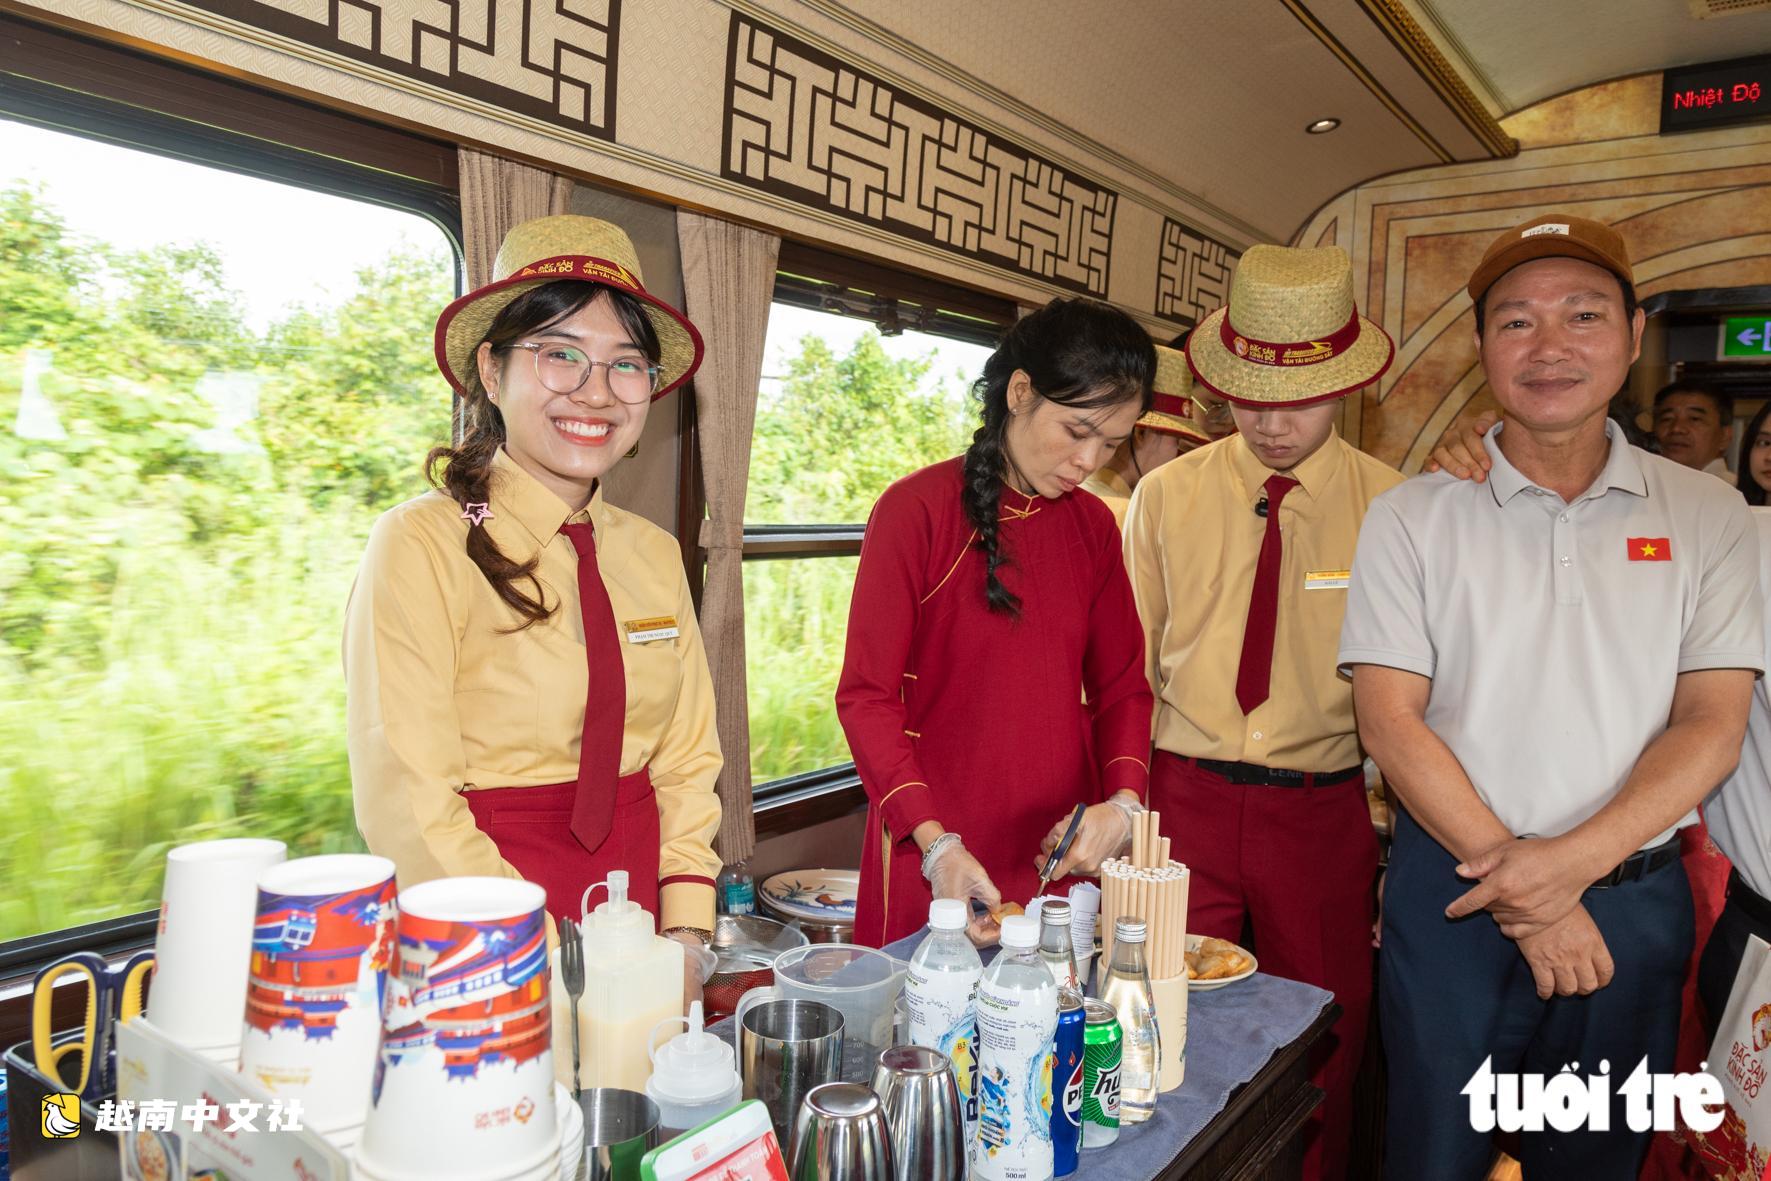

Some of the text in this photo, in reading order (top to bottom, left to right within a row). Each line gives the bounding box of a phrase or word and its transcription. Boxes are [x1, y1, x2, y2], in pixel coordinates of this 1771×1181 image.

[1673, 82, 1761, 110] Nhiệt Độ
[1726, 1056, 1745, 1082] KINH
[1731, 1041, 1751, 1067] ĐẶC
[1747, 1059, 1768, 1085] SẢN
